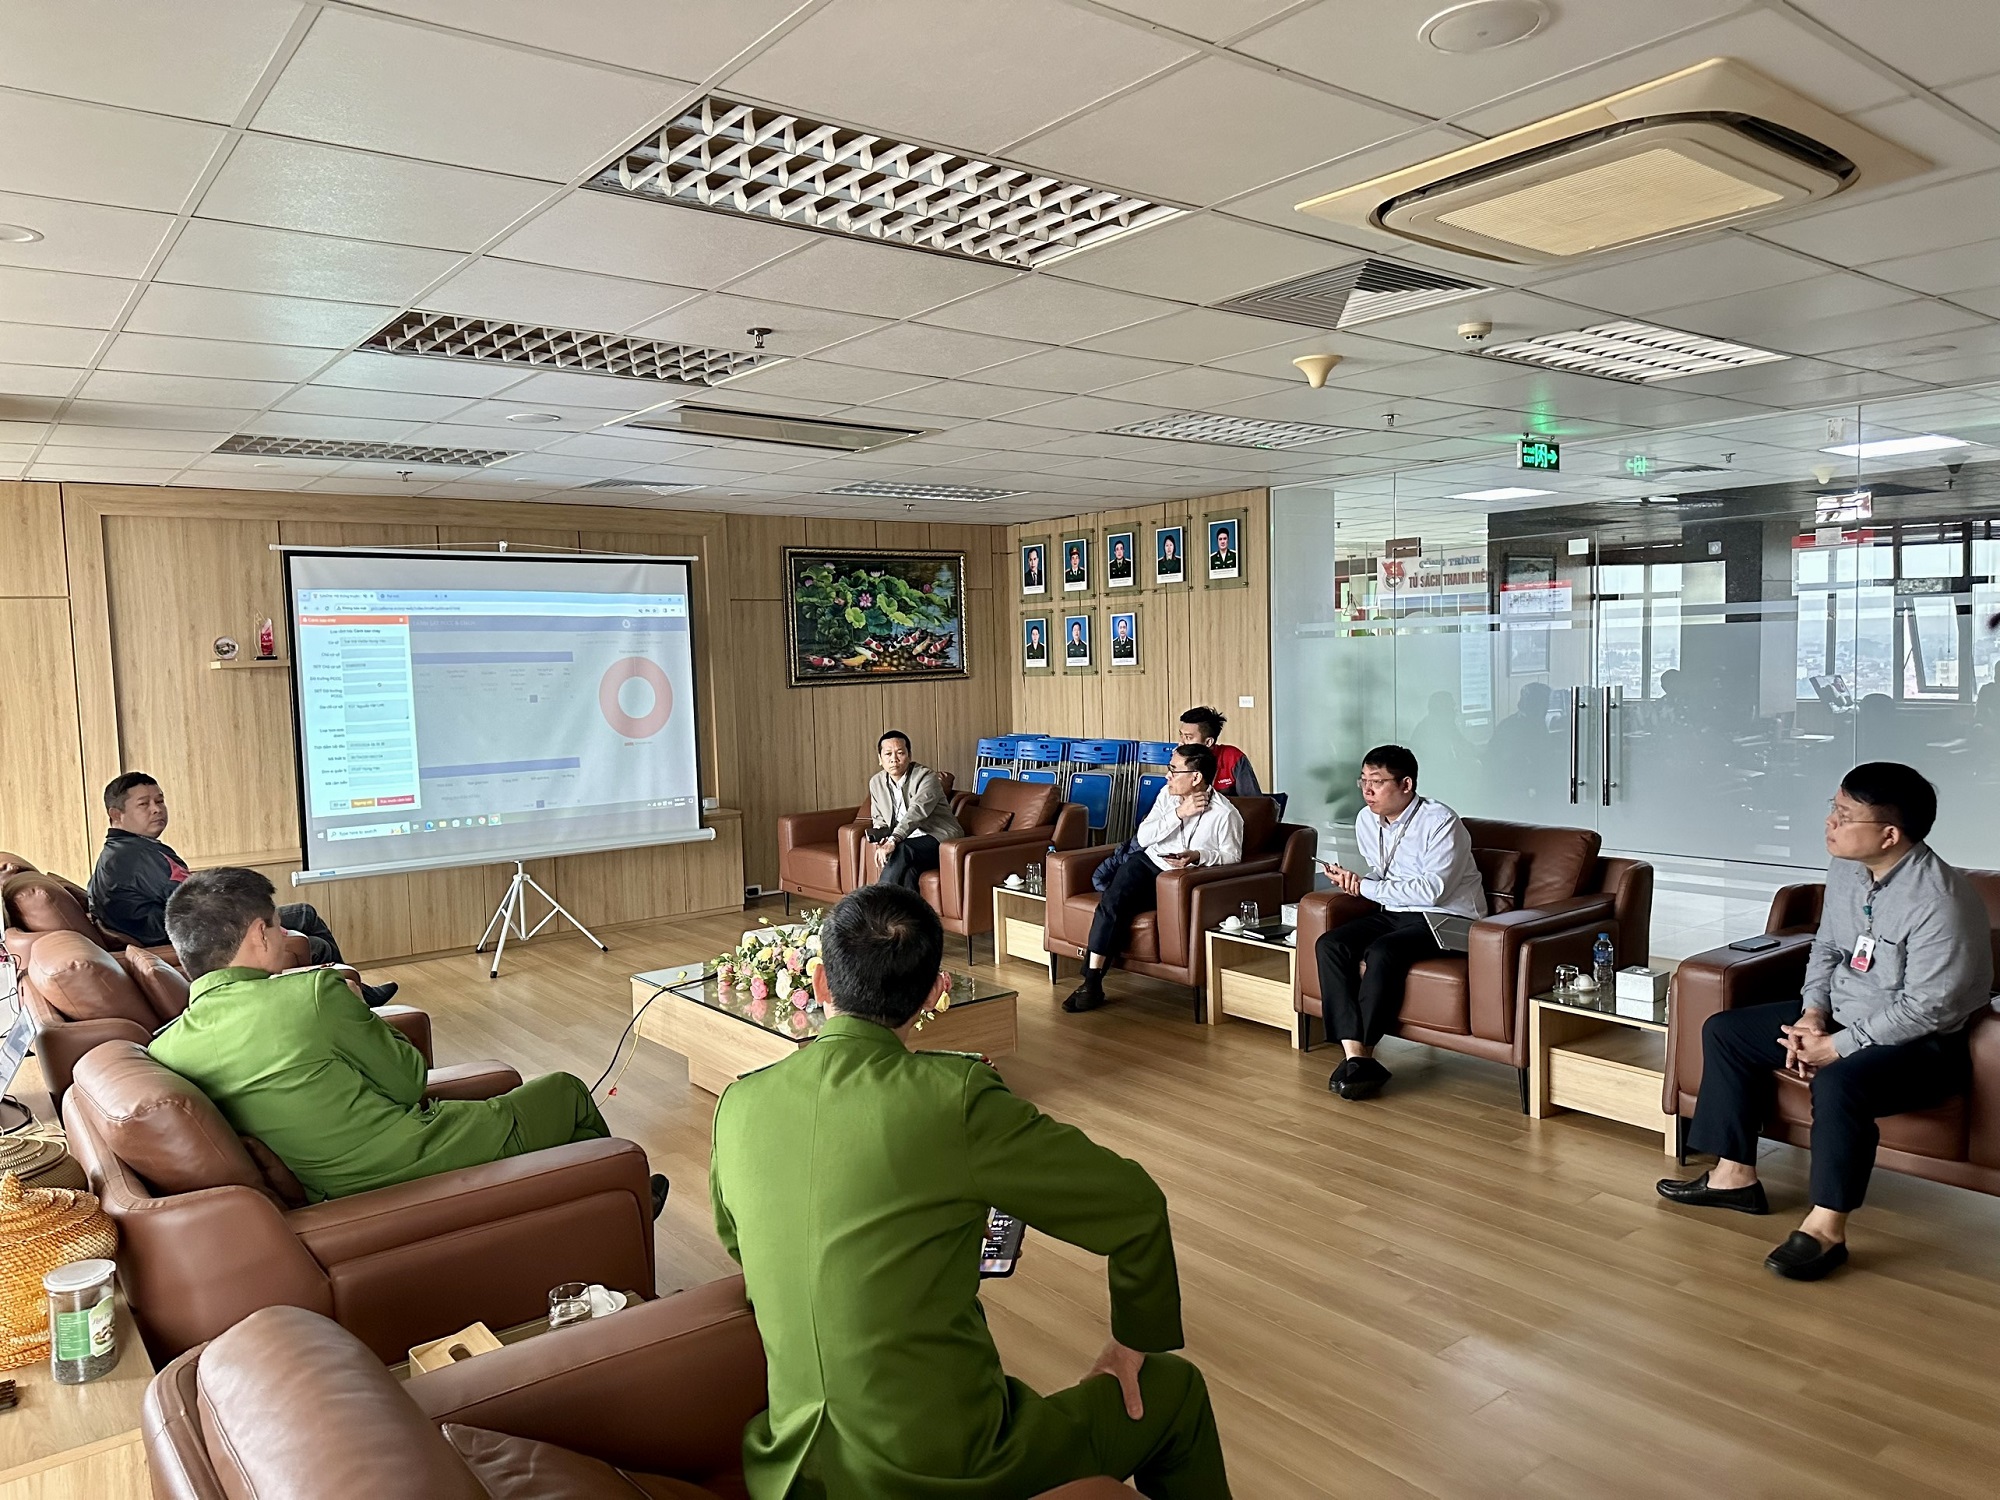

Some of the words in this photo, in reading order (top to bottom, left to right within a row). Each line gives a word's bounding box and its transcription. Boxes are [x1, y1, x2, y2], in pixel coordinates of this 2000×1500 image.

[1448, 555, 1481, 567] TRÌNH
[1408, 572, 1418, 588] TỦ
[1420, 572, 1441, 588] SÁCH
[1443, 571, 1470, 586] THANH
[1471, 568, 1489, 585] NIÊ
